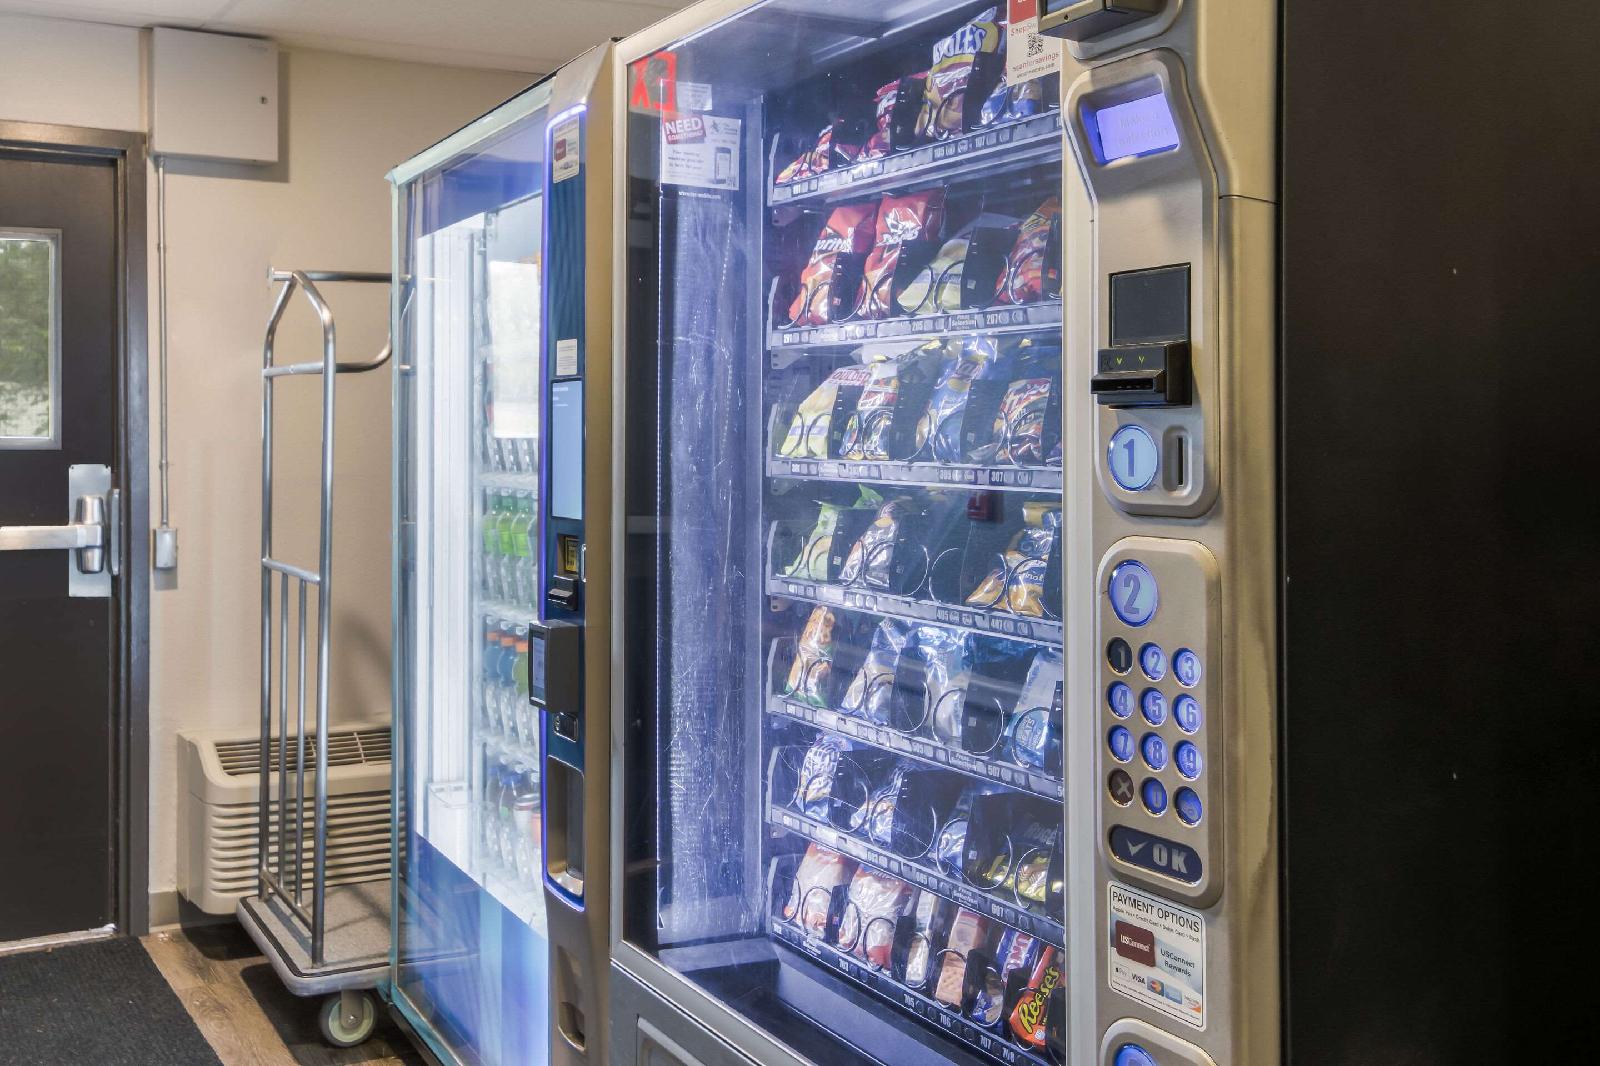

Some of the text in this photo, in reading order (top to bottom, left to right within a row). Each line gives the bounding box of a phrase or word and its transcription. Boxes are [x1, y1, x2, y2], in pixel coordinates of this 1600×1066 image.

[665, 117, 702, 135] NEED
[986, 313, 998, 324] 207
[1122, 438, 1135, 477] 1
[1123, 573, 1140, 614] 2
[1117, 645, 1195, 680] 1 2 3
[1117, 689, 1197, 726] 4 5 6
[1119, 732, 1196, 772] 7 8 9
[987, 764, 1000, 778] 507
[1152, 843, 1188, 874] OK
[1112, 891, 1200, 933] PAYMENT OPTIONS
[1160, 948, 1195, 969] USConnect
[1164, 960, 1192, 977] Rewards
[1131, 972, 1146, 986] VISA
[1018, 966, 1060, 1034] Reese's
